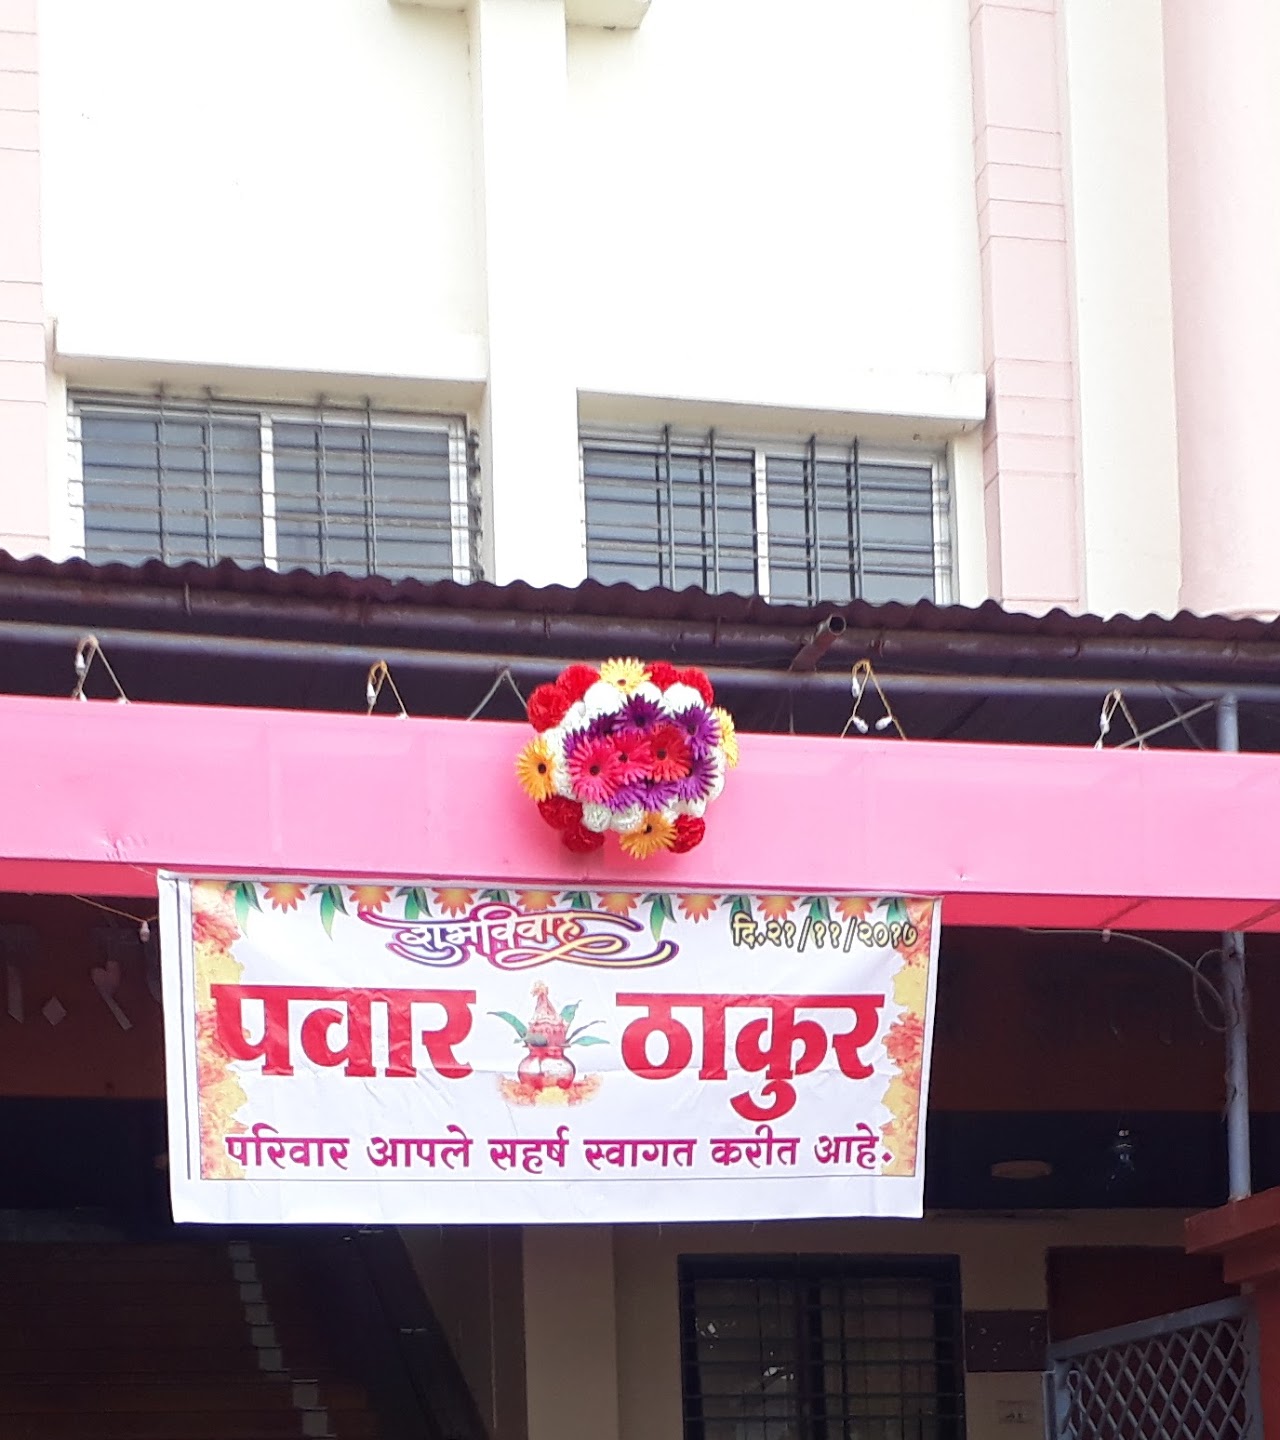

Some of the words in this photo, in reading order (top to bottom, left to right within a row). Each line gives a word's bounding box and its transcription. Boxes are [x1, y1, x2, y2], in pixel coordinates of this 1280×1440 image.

[211, 984, 477, 1079] पवार
[616, 993, 885, 1122] ठाकुर
[225, 1122, 350, 1170] परिवार
[367, 1124, 474, 1169] आपले
[488, 1125, 569, 1174] सहर्ष
[583, 1138, 697, 1170] स्वागत
[710, 1124, 801, 1168] करीत
[814, 1123, 893, 1169] आहे.
